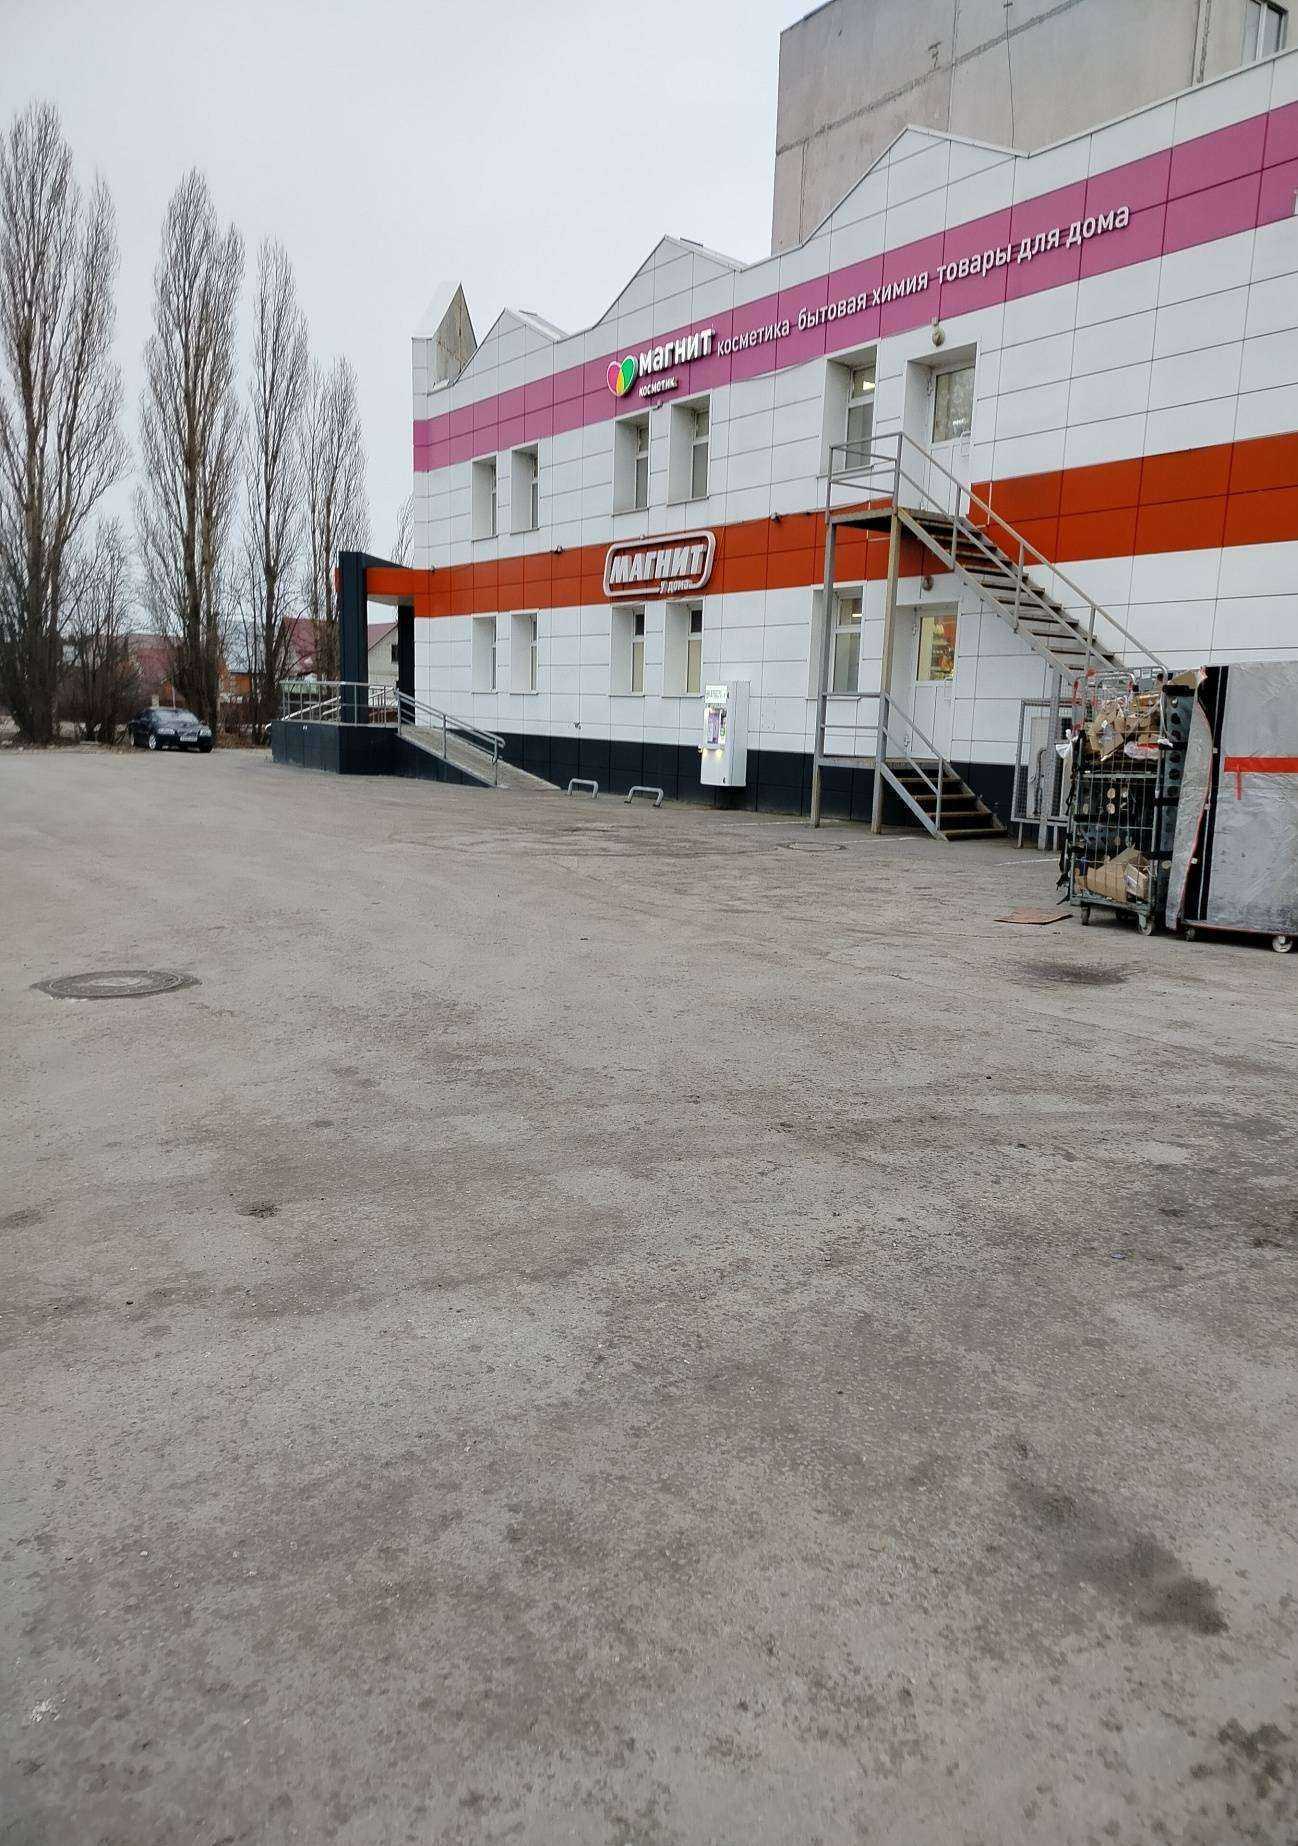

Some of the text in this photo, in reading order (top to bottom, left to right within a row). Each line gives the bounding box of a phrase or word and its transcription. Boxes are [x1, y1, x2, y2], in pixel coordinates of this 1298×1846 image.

[717, 206, 1130, 356] косметика бытовая химия товары для дома
[609, 544, 706, 584] МАГНИТ
